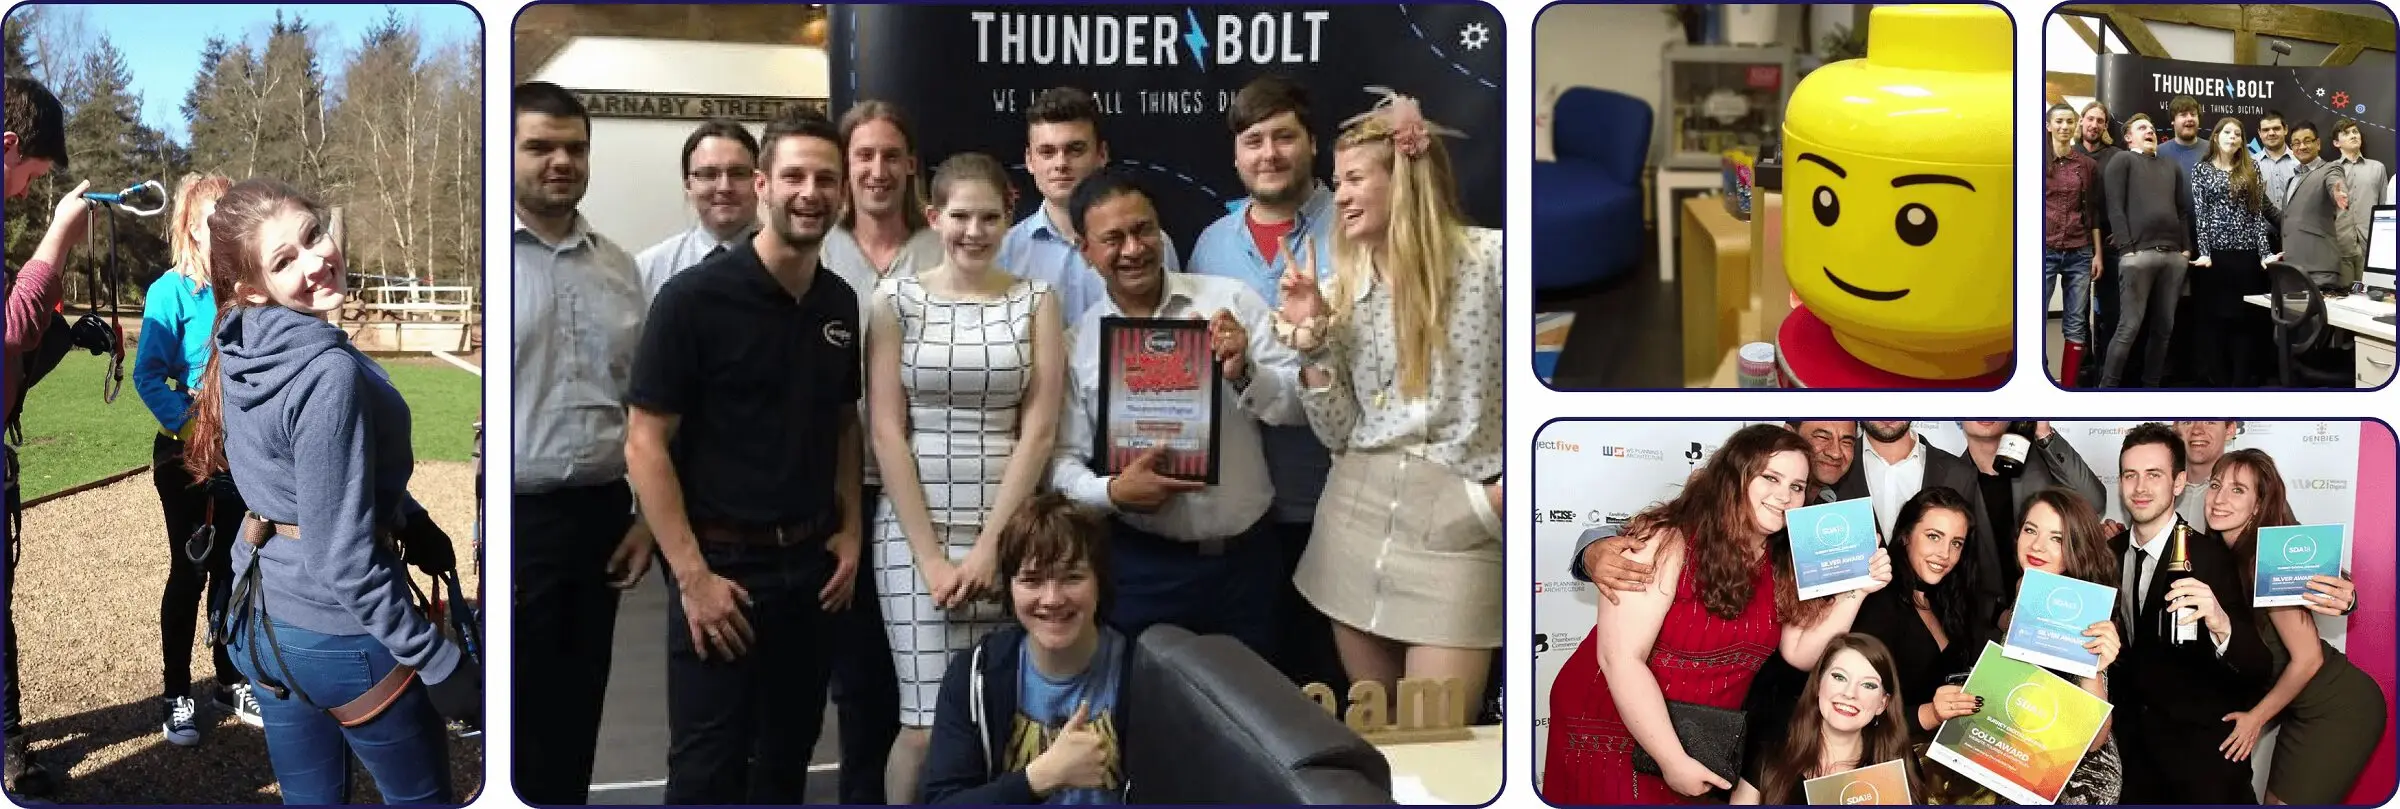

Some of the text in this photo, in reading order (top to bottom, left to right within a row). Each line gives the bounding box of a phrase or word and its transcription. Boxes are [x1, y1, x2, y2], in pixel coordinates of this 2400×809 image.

[971, 11, 1330, 66] THUNDER BOLT
[2152, 73, 2275, 99] THUNDER BOLT
[579, 94, 690, 117] ARNABY
[699, 98, 782, 120] STREET
[992, 88, 1016, 113] WE
[1139, 90, 1203, 115] THINGS
[2159, 101, 2169, 111] WE
[2210, 104, 2234, 114] THINGS
[1971, 727, 1996, 744] GOLD
[1994, 741, 2030, 761] AWARD
